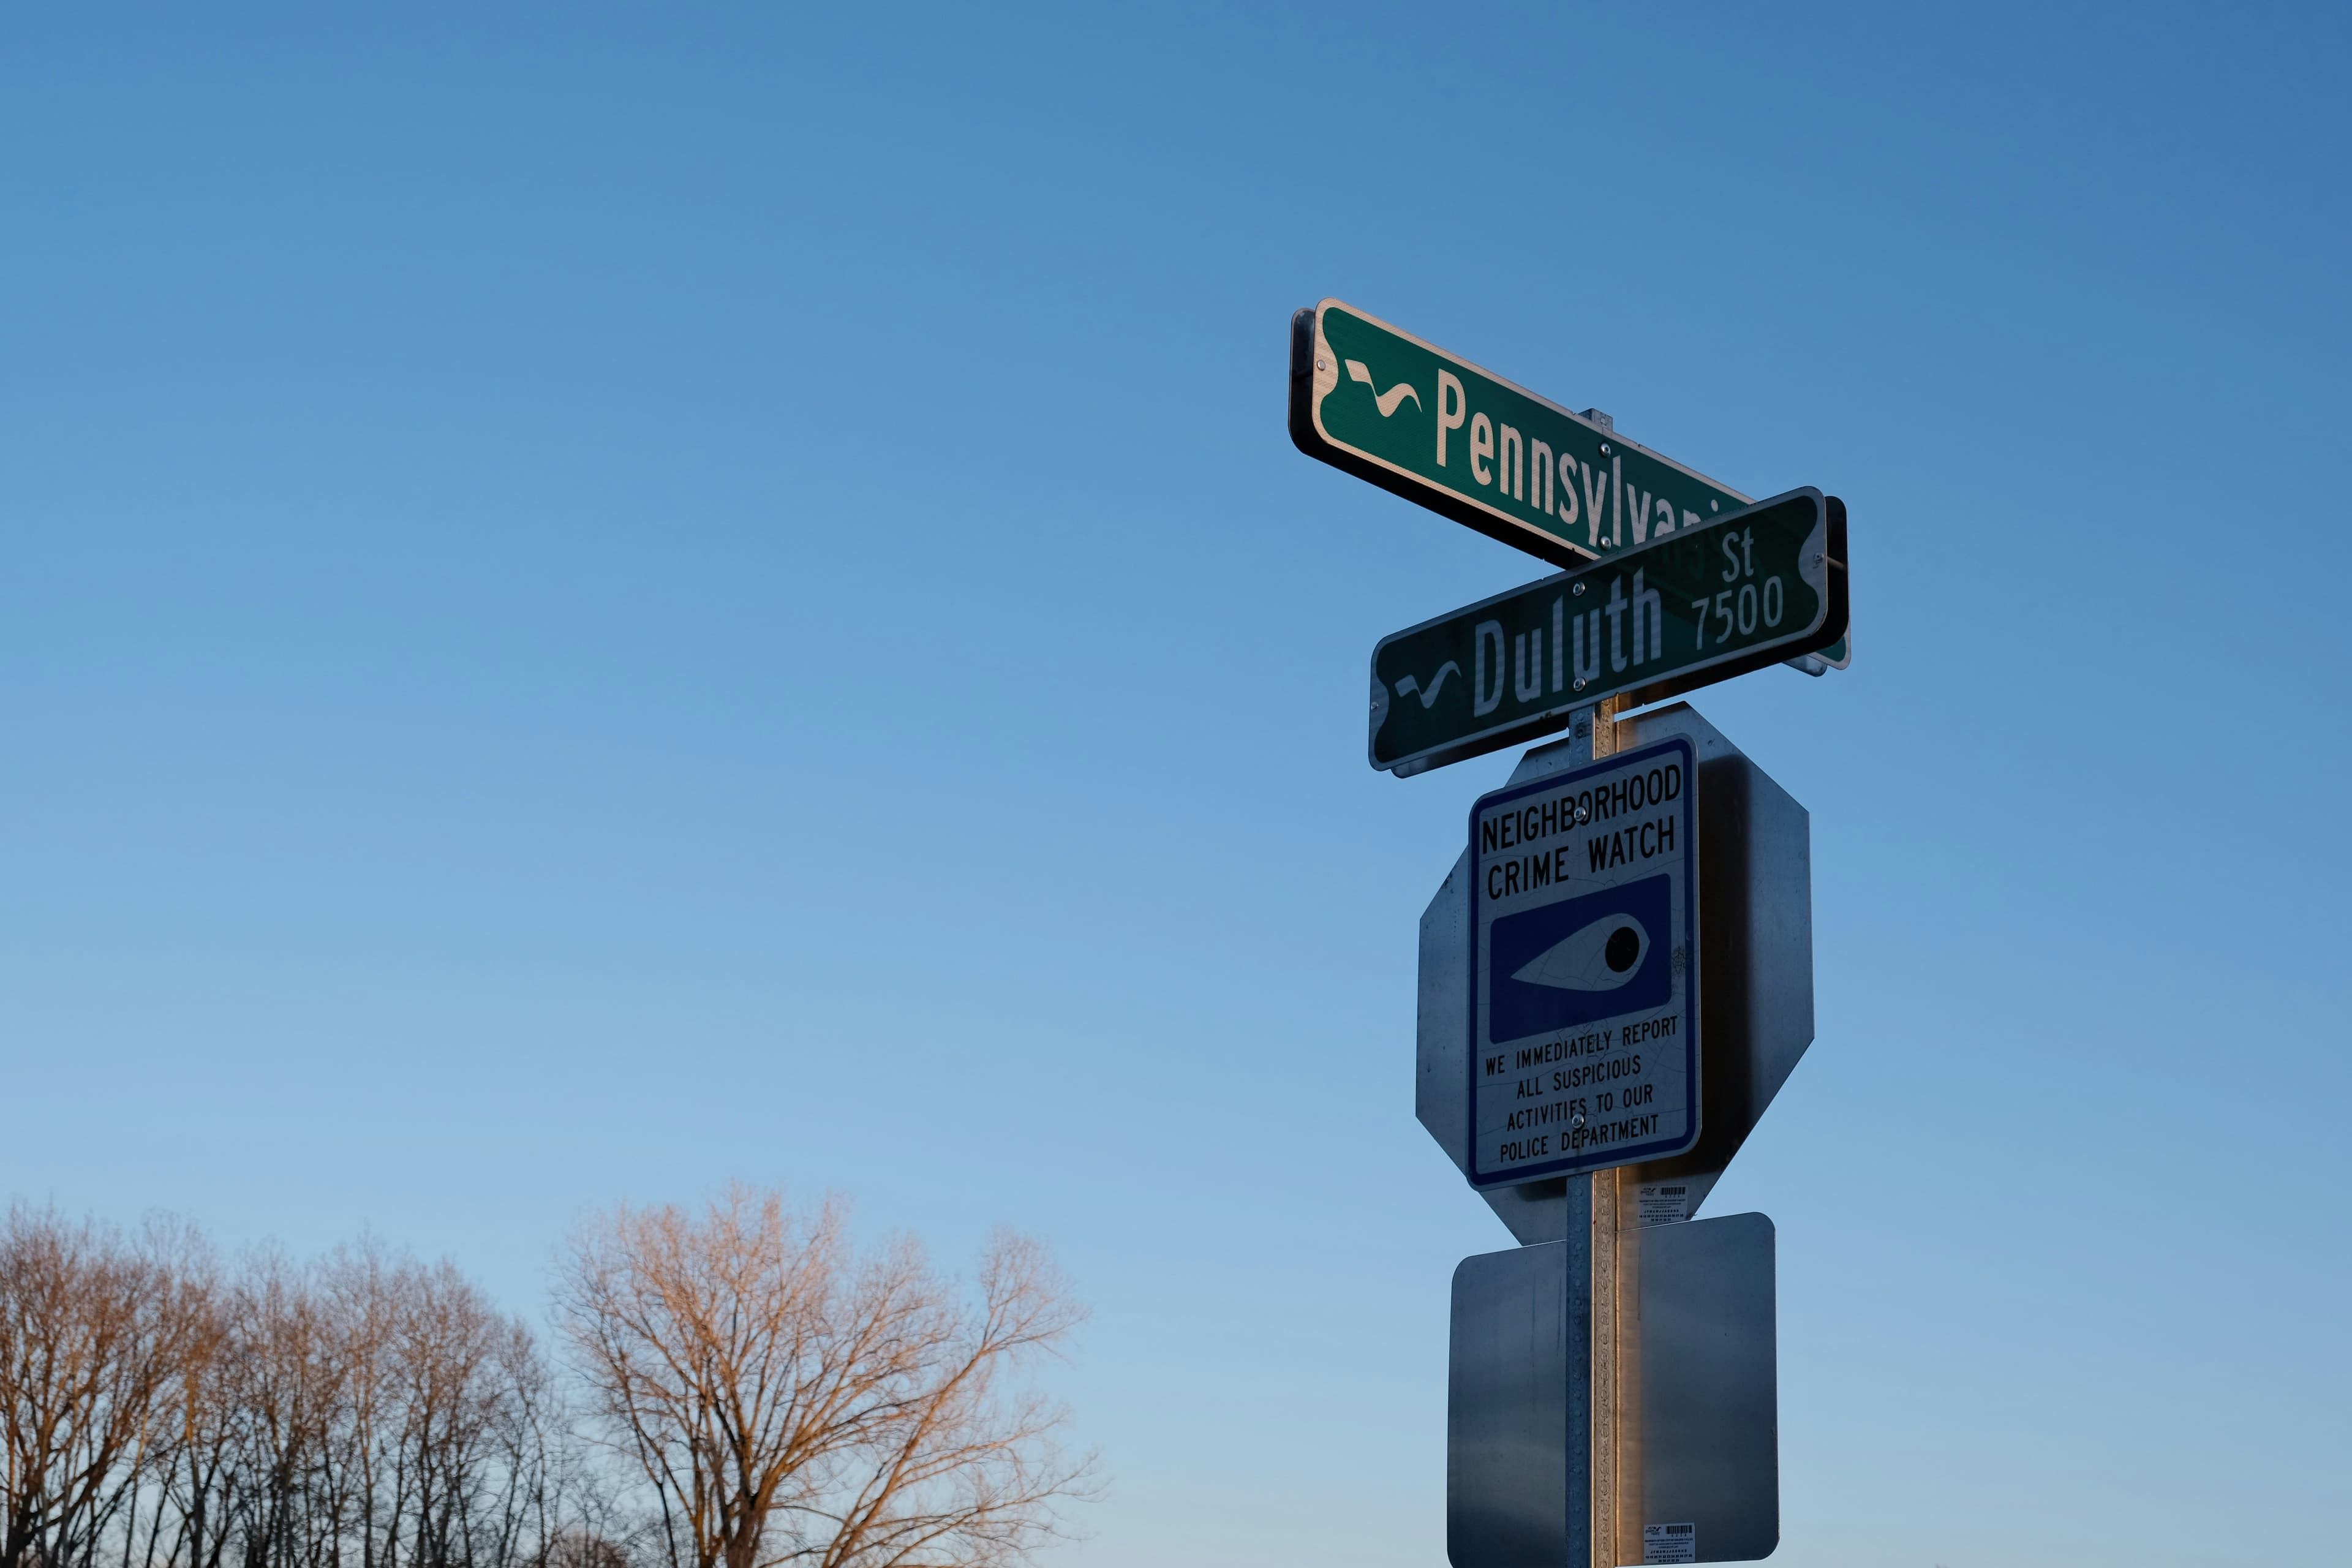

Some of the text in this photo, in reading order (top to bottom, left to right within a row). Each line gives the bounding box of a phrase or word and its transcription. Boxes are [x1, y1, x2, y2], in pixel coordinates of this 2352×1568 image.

[1436, 368, 1719, 548] Pennsylva
[1473, 526, 1754, 718] Duluth St
[1692, 575, 1784, 650] 7500
[1482, 764, 1681, 854] NEIGHBORHOOD
[1488, 815, 1674, 900] CRIME WATCH
[1486, 1016, 1678, 1076] WE IMMEDIATELY REPORT
[1517, 1055, 1641, 1099] ALL SUSPICIOUS
[1500, 1114, 1659, 1163] POLICE DEPARTMENT
[1507, 1084, 1653, 1131] ACTIVITIES TO OUR
